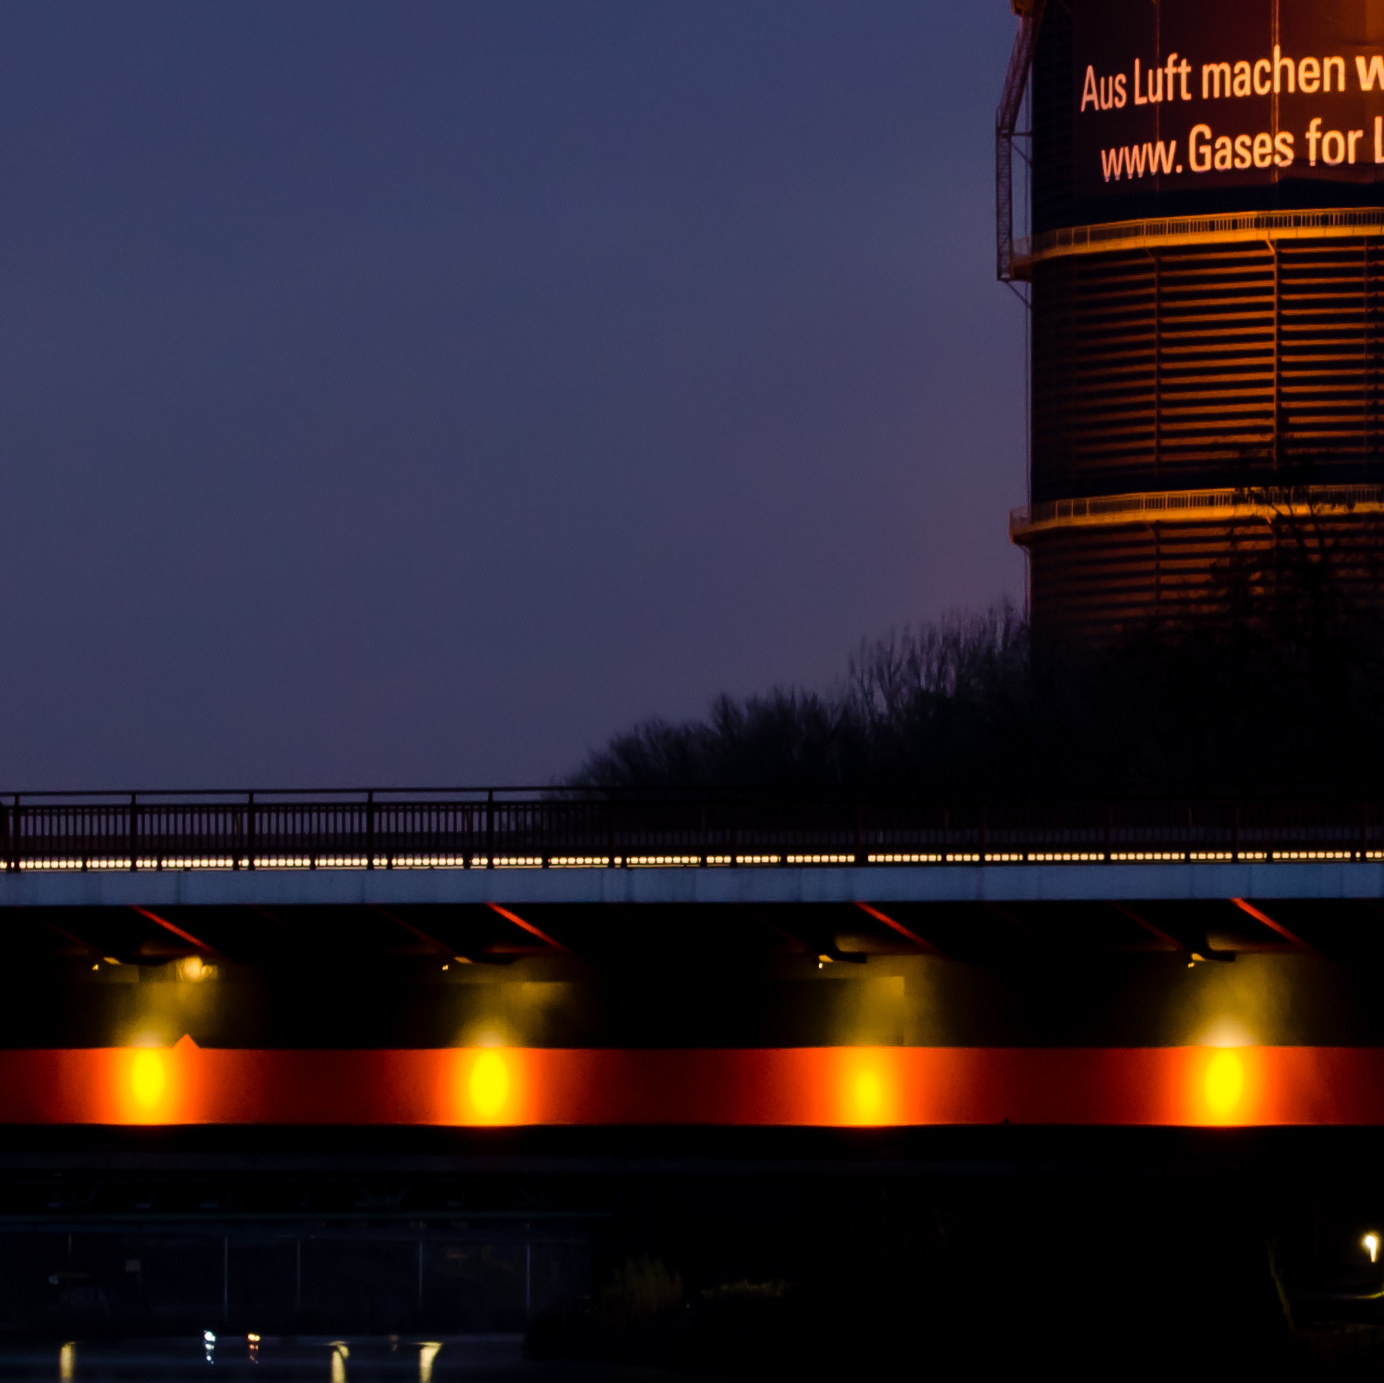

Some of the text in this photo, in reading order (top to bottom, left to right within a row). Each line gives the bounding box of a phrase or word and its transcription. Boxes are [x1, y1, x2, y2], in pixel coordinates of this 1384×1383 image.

[1080, 65, 1127, 112] Aus
[1134, 53, 1192, 105] Luft
[1202, 44, 1345, 99] machen
[1305, 119, 1364, 167] for
